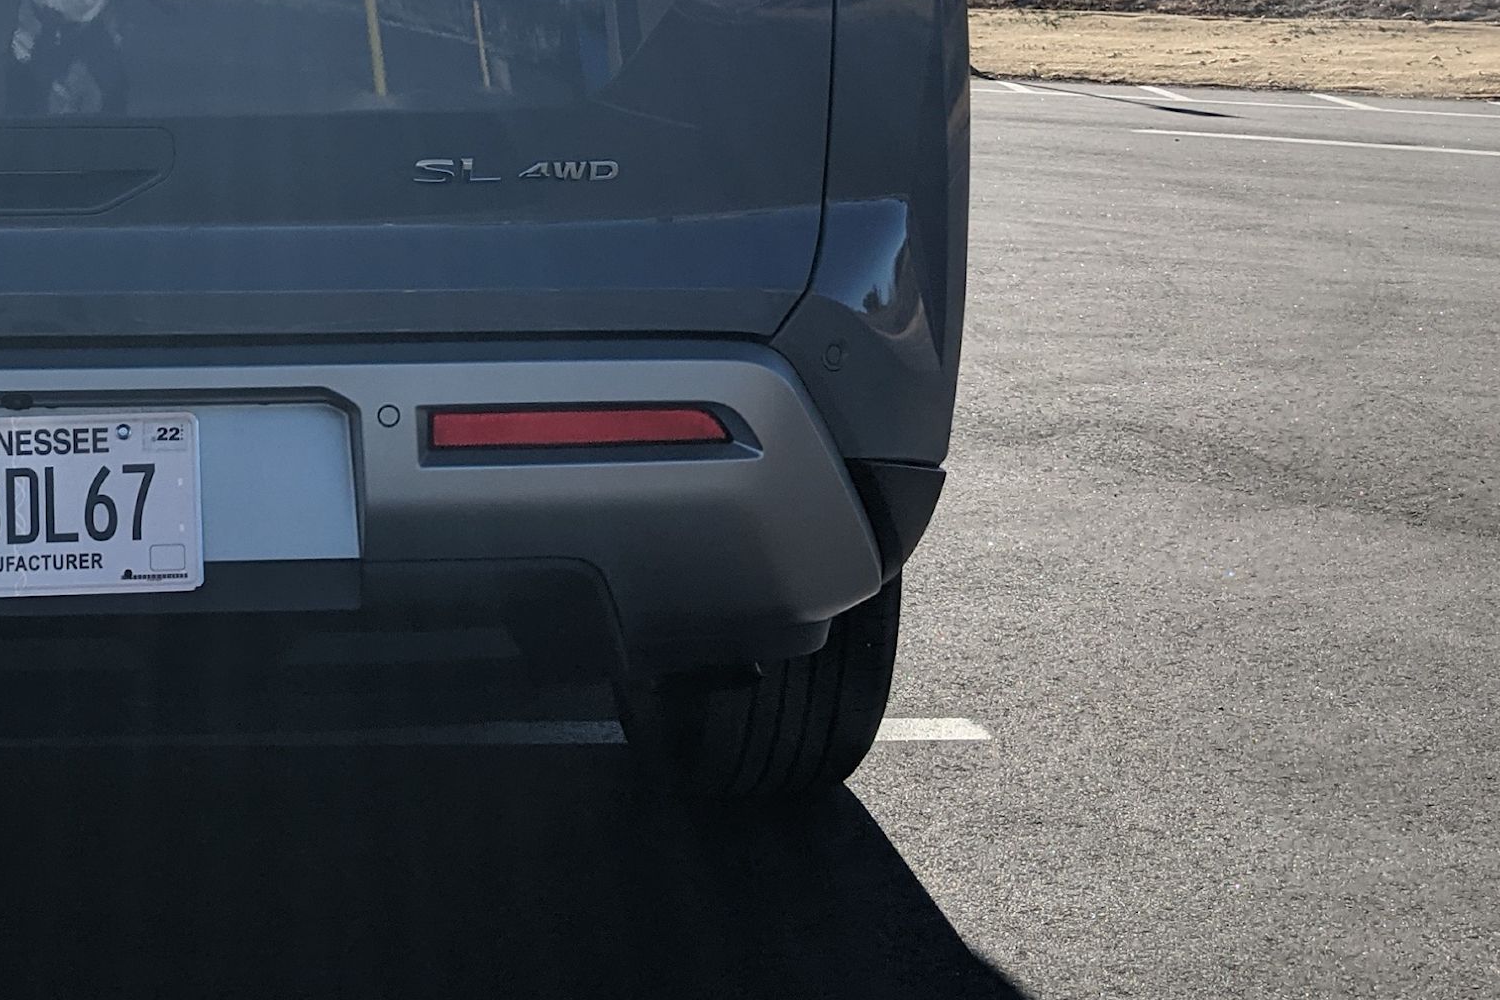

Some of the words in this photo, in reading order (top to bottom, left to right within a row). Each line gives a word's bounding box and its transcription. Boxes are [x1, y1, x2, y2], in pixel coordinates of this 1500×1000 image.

[413, 158, 502, 183] SL
[518, 160, 620, 181] AWD
[156, 427, 181, 441] 22
